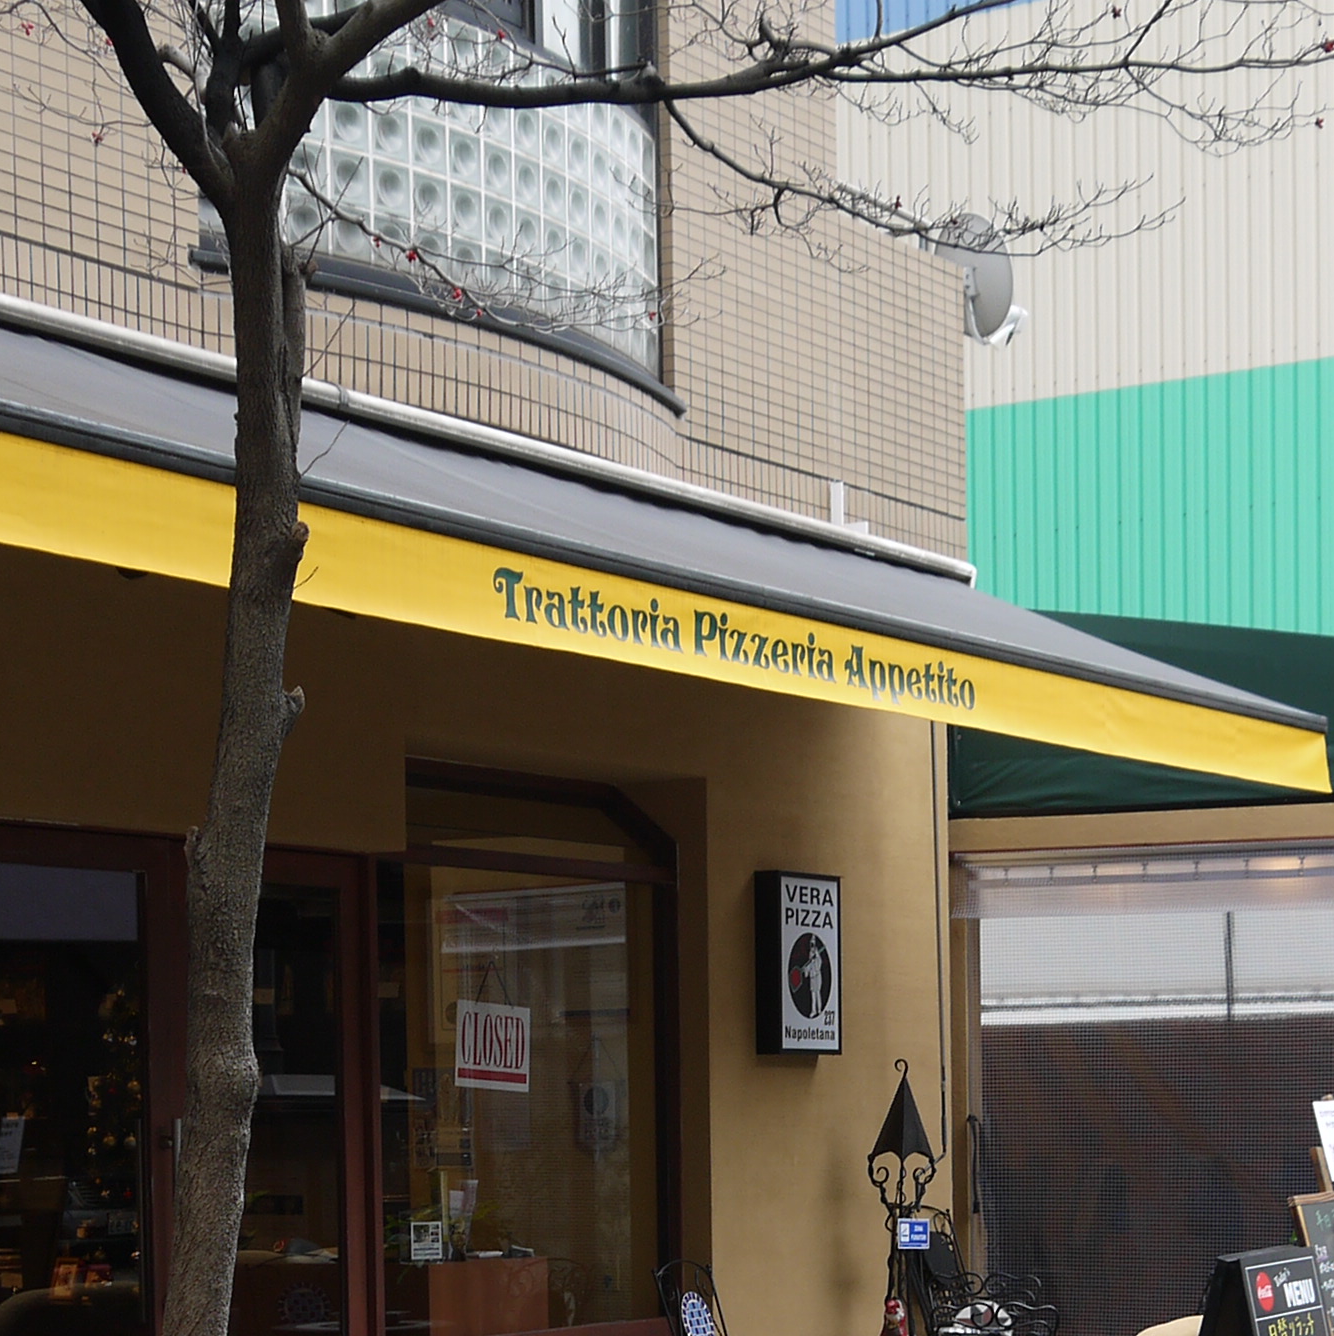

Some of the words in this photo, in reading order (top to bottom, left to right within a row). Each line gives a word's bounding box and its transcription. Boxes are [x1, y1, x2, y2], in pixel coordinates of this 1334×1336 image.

[493, 567, 681, 653] Trattoria
[693, 610, 836, 684] Pizzeria
[844, 645, 976, 711] Appetito
[785, 884, 834, 907] VERA
[785, 907, 833, 929] PIZZA
[462, 1011, 526, 1070] CLOSED
[785, 1025, 835, 1042] Napoletana
[1283, 1278, 1316, 1308] MENU
